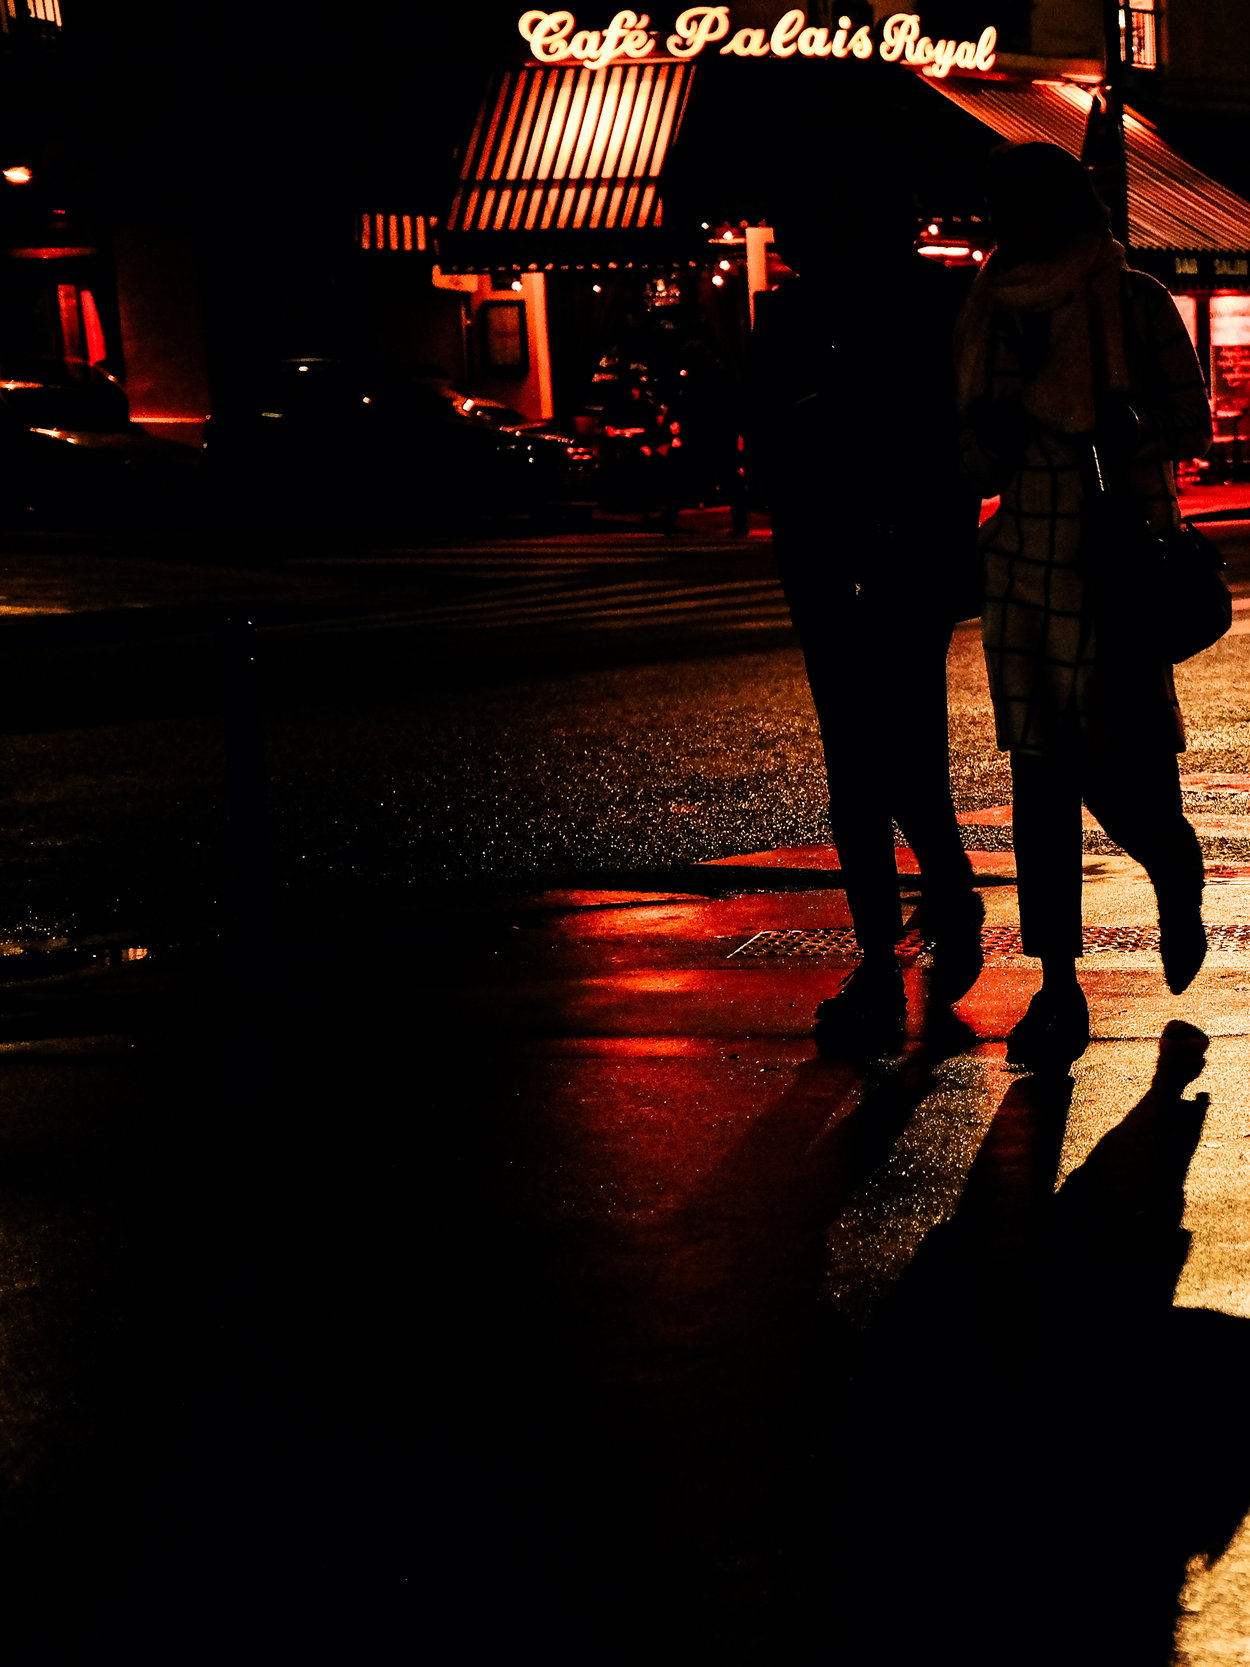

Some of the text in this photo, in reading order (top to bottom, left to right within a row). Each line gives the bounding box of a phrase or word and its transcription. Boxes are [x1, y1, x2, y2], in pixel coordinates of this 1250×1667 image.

[518, 6, 998, 78] Café Palais Royal
